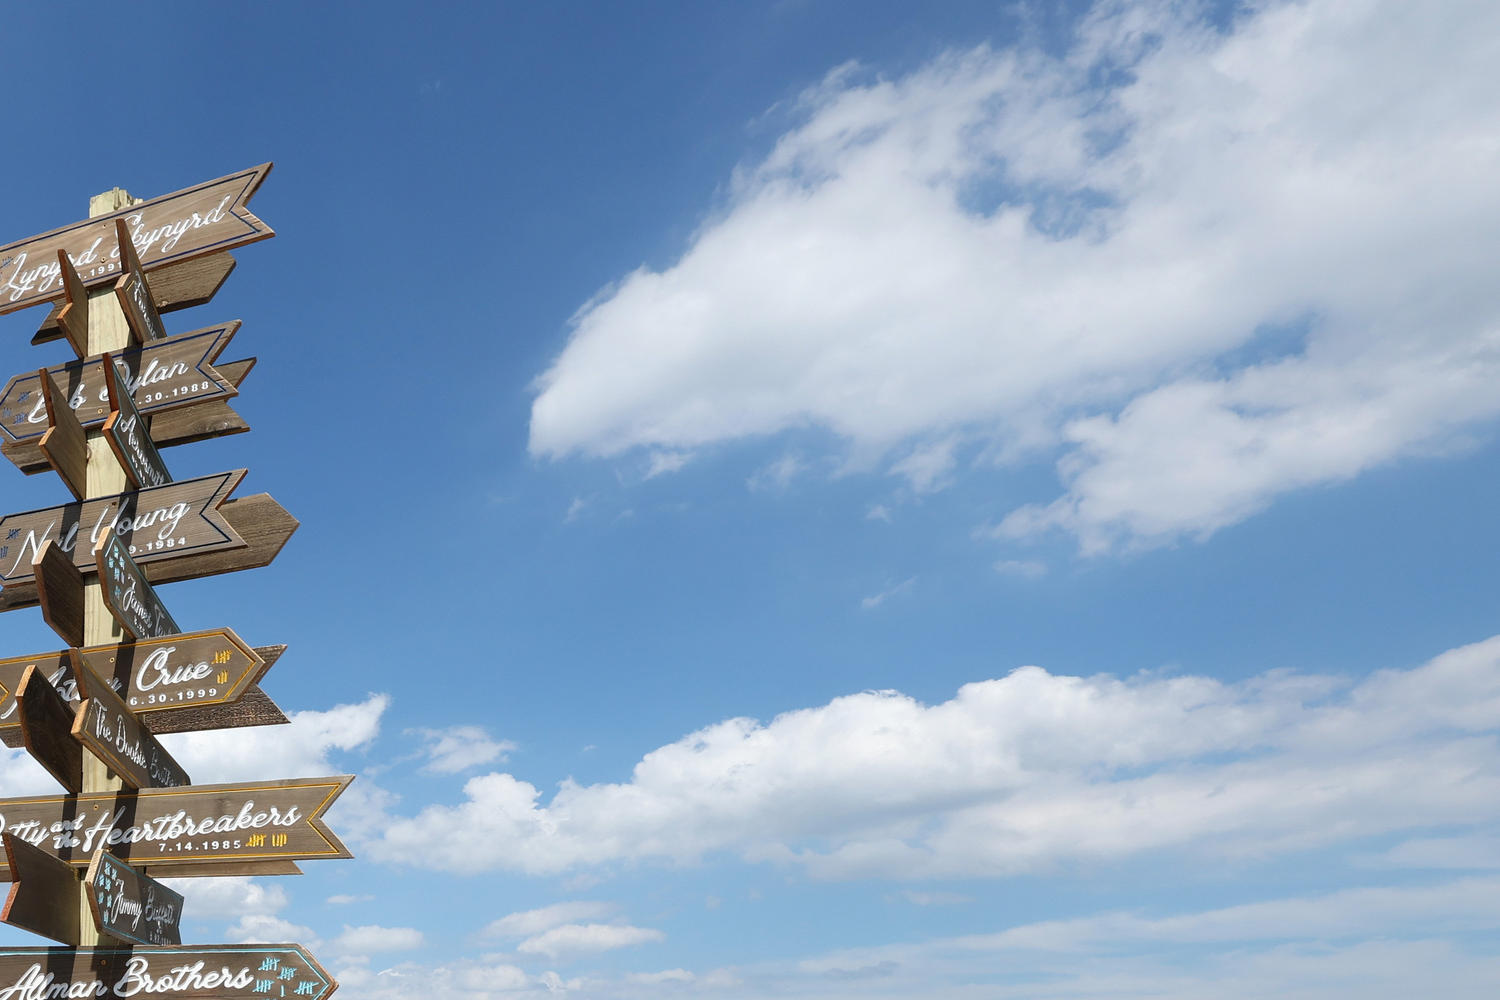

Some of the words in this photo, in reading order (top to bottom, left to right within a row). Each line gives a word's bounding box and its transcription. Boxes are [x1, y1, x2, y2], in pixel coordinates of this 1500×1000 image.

[27, 382, 87, 423] Bb
[130, 687, 217, 706] 6.30.1999
[93, 697, 112, 742] The
[50, 812, 86, 832] and
[52, 831, 81, 849] the
[81, 800, 302, 853] Heartbreakers
[158, 838, 241, 852] 7.14.1985
[111, 878, 142, 932] Jimmy
[112, 956, 255, 998] Brothers
